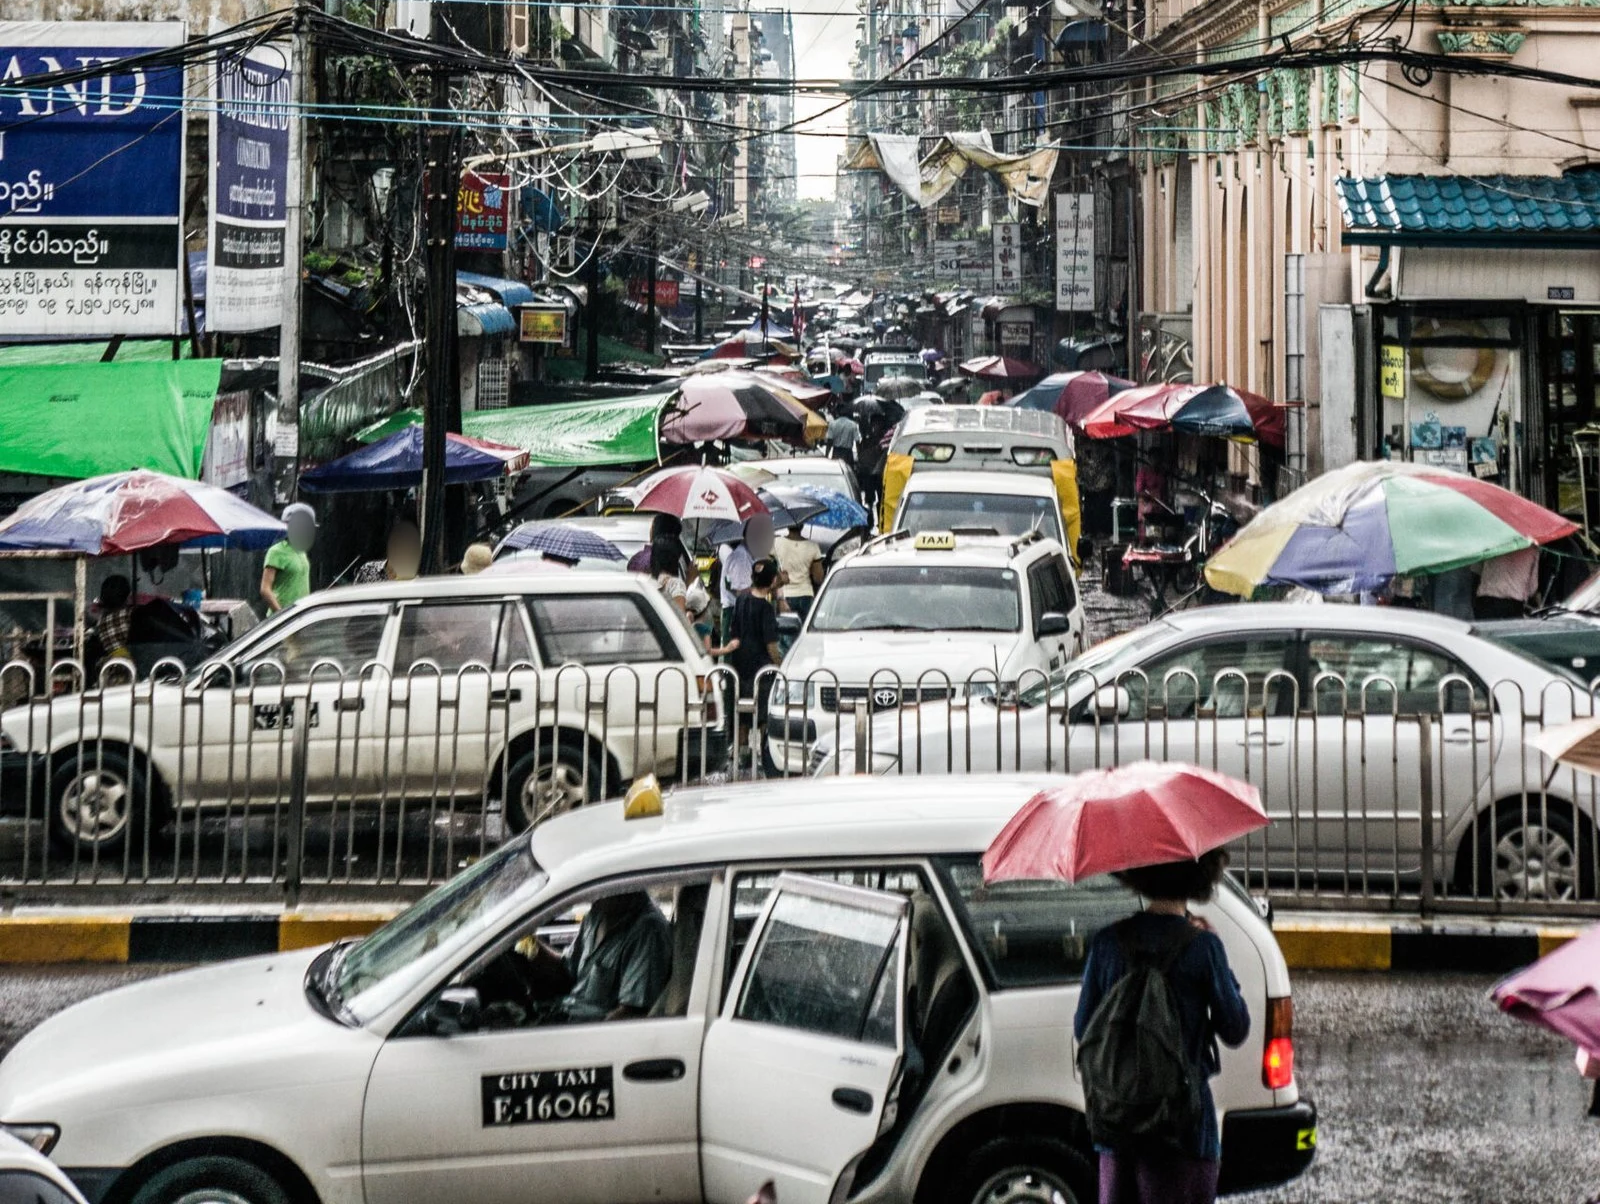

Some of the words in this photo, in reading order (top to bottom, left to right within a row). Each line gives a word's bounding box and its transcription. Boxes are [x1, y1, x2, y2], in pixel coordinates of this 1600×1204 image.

[921, 535, 949, 545] TAXI
[499, 1074, 540, 1090] CITY
[555, 1069, 597, 1086] TAXI
[494, 1090, 610, 1123] E-16065
